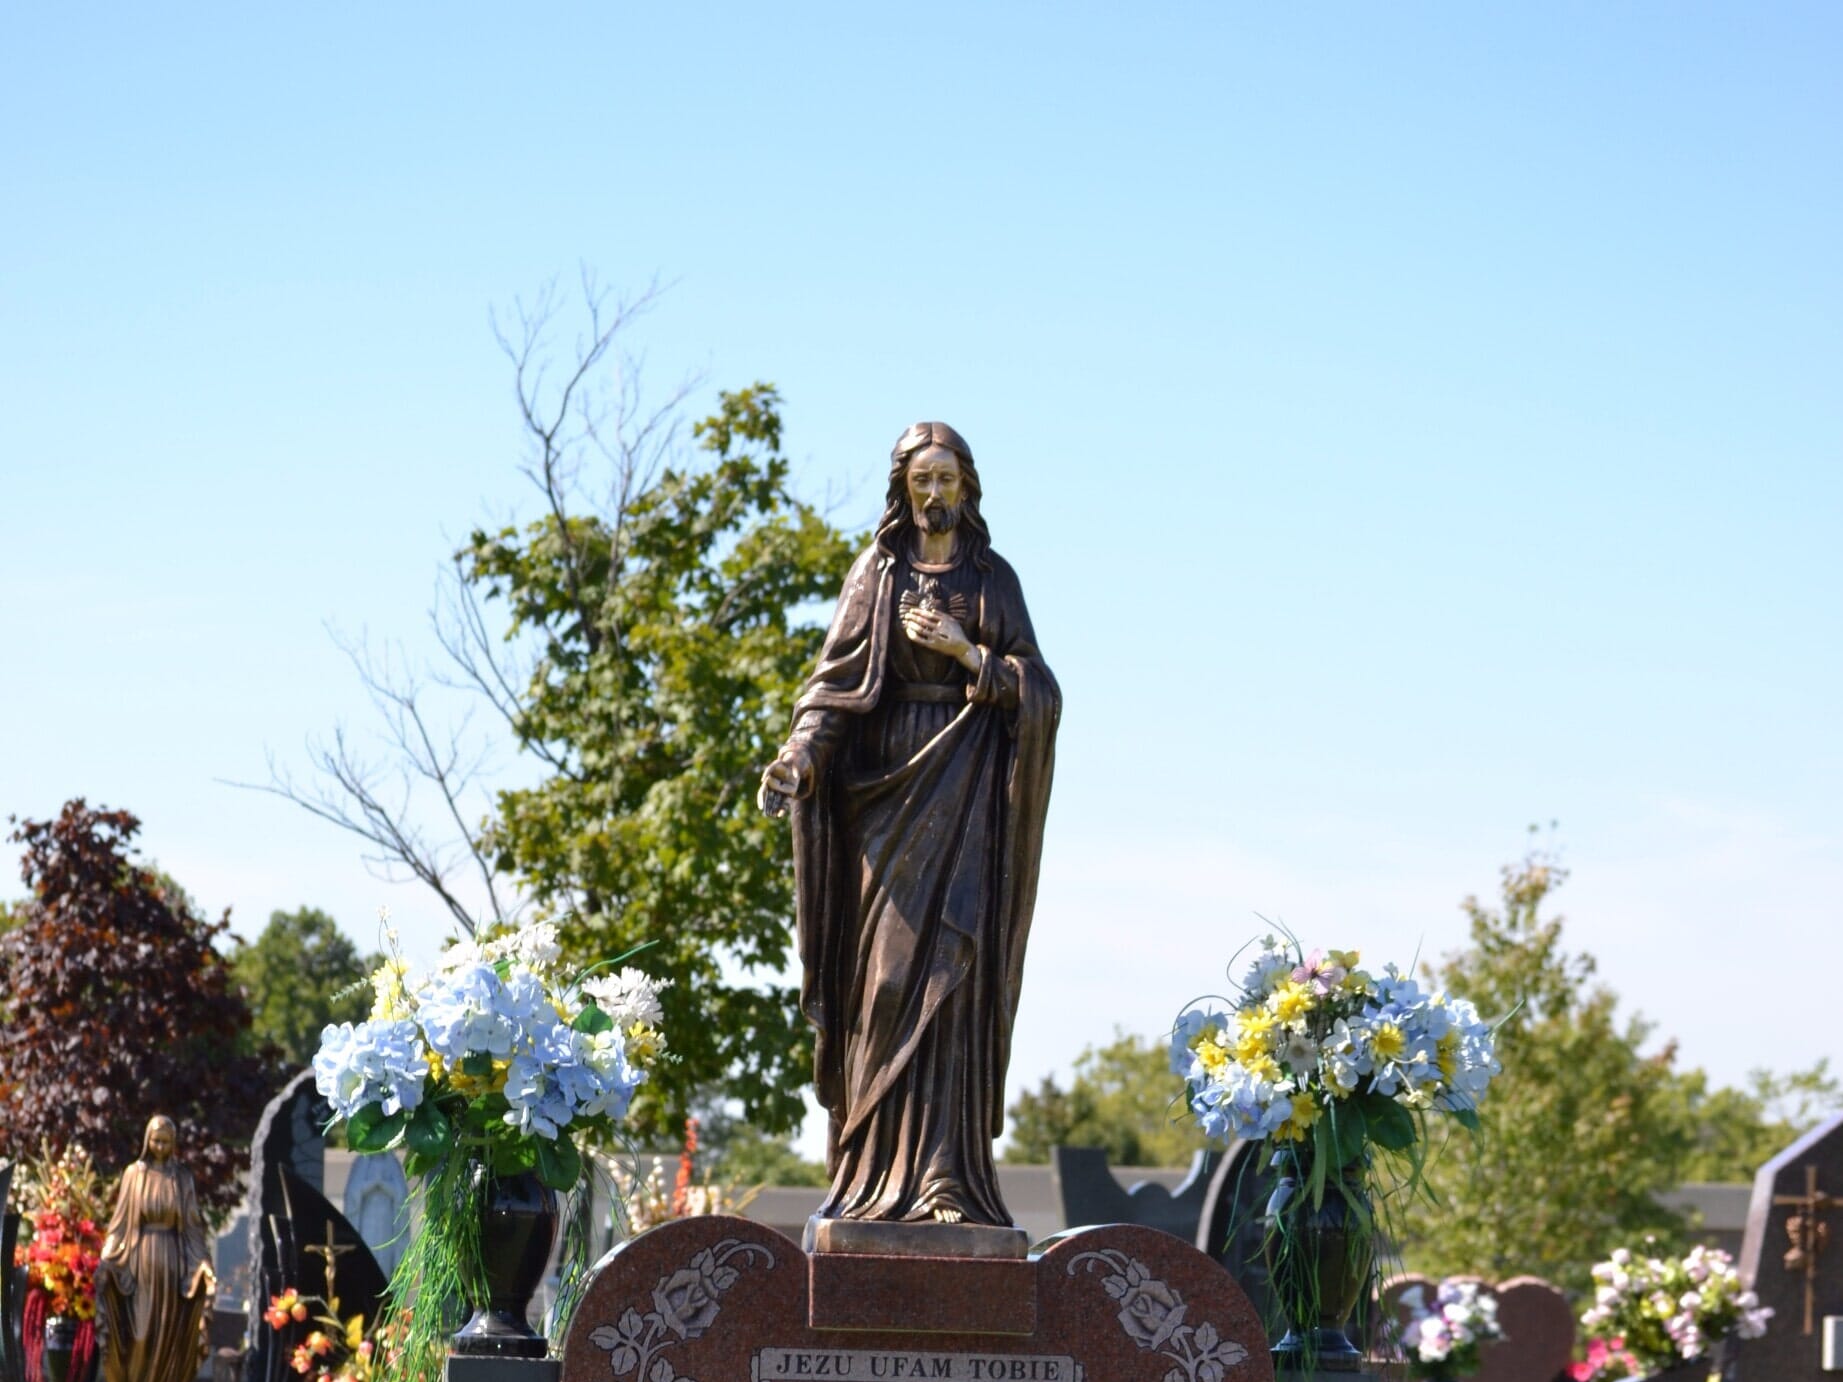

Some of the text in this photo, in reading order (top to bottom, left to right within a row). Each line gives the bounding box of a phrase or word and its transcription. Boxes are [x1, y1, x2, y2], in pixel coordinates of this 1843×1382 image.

[776, 1353, 1061, 1382] JEZU UFAM TOBIE
